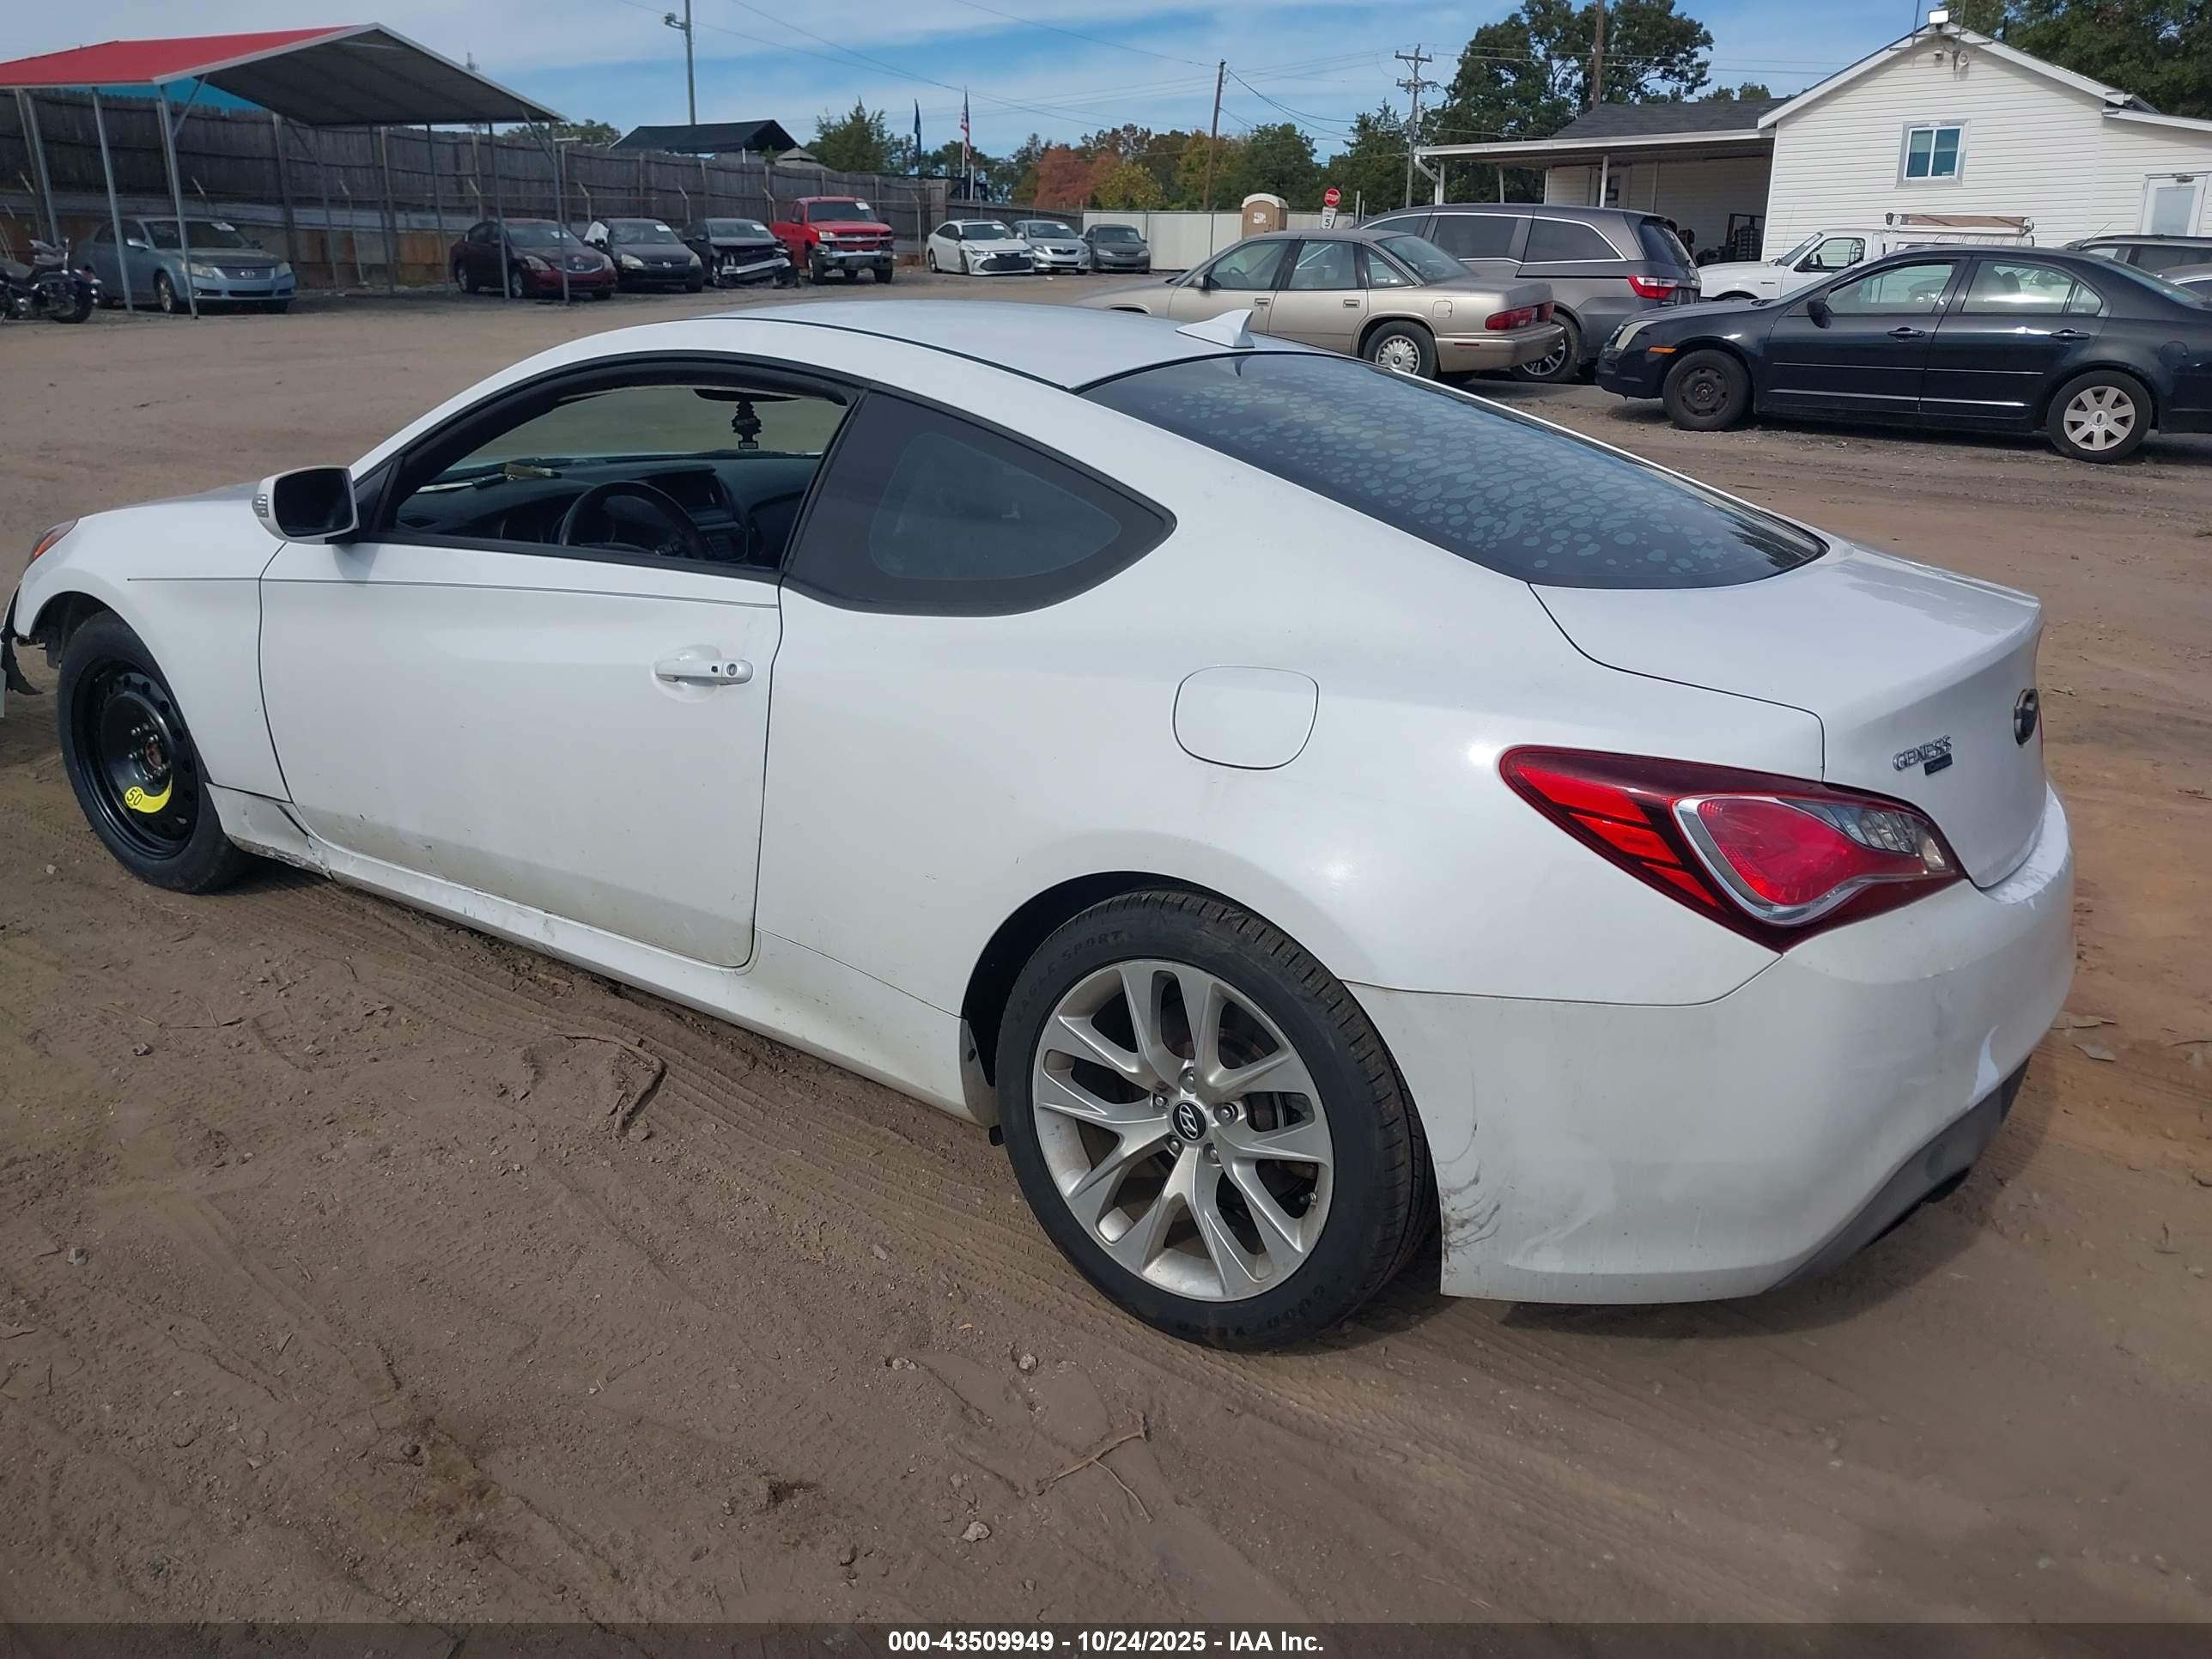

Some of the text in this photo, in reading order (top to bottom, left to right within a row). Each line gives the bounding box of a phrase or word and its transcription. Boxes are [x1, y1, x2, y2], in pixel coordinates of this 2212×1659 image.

[1324, 218, 1331, 227] 5
[126, 788, 143, 806] 50
[1061, 929, 1123, 962] SPORT
